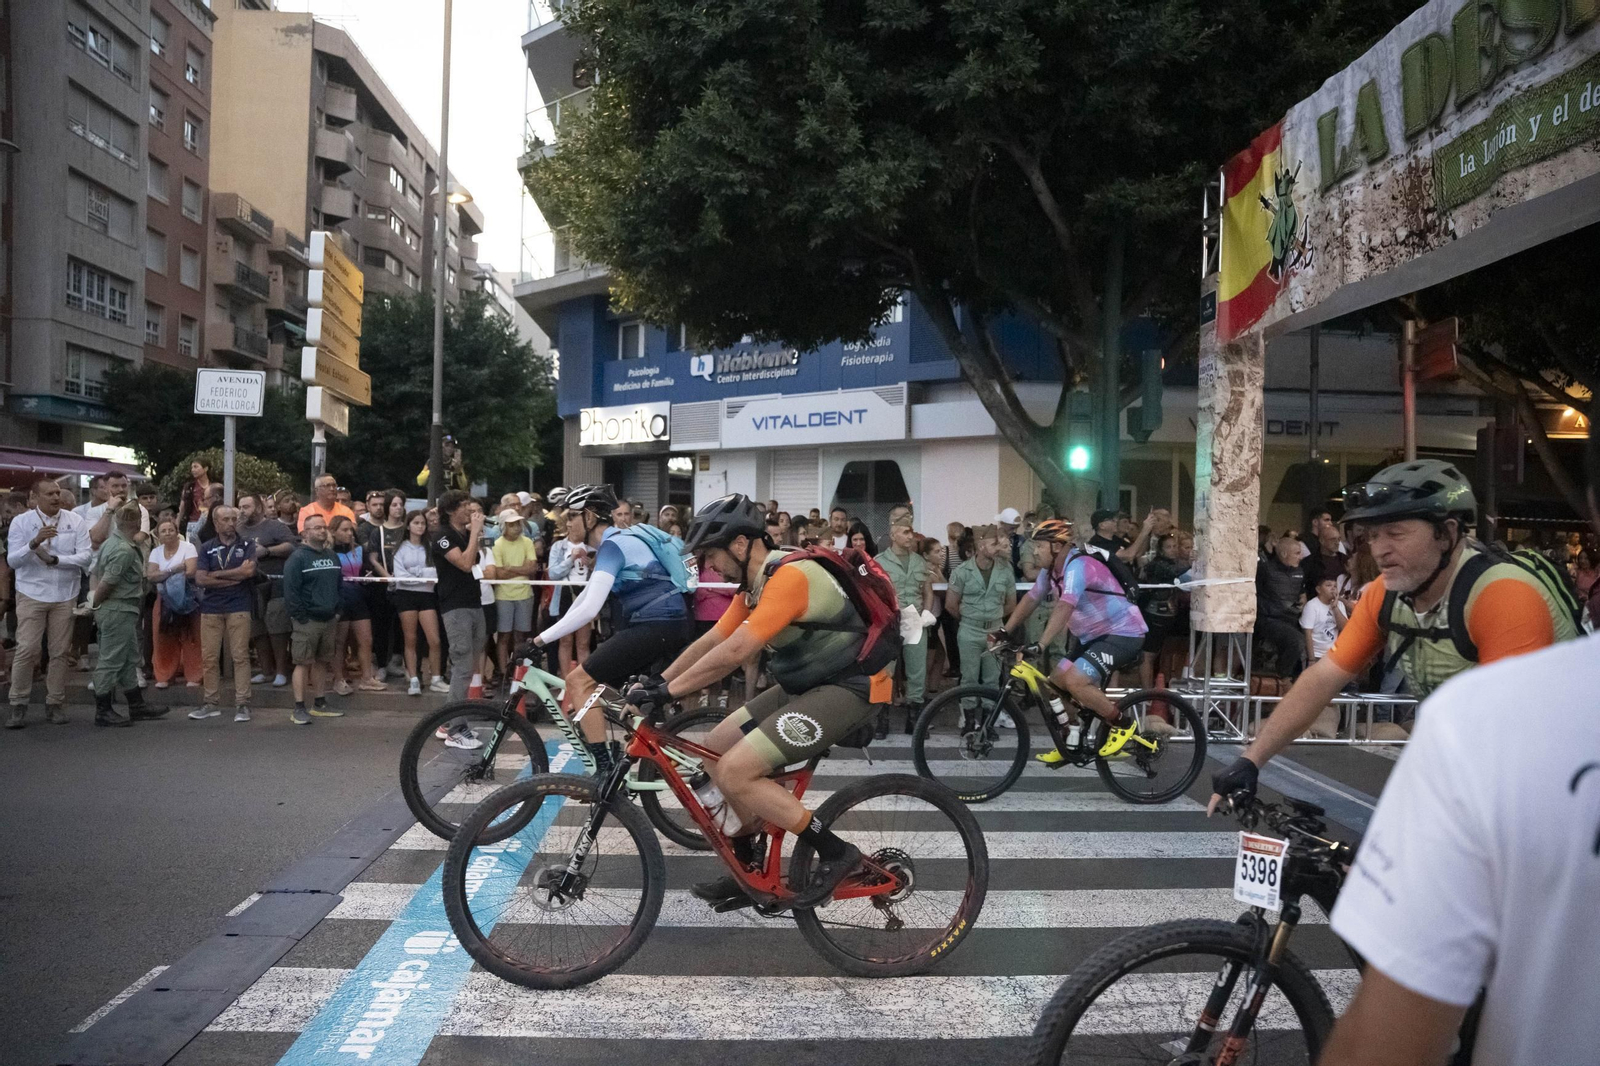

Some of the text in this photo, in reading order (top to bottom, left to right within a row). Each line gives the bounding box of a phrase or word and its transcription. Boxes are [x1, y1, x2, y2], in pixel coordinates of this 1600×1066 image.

[1459, 152, 1476, 178] La
[1529, 113, 1543, 142] y
[1552, 93, 1569, 126] el
[841, 351, 894, 367] Fisioterapia
[217, 376, 258, 384] AVENIDA
[717, 366, 799, 384] Centro Interdisciplinar
[210, 387, 248, 398] FEDERICO
[613, 381, 641, 392] Medicina
[231, 400, 256, 411] LORCA
[752, 409, 868, 430] VITALDENT
[1241, 854, 1278, 887] 5398
[931, 919, 966, 957] MAXXIS
[338, 959, 431, 1060] cajamar
